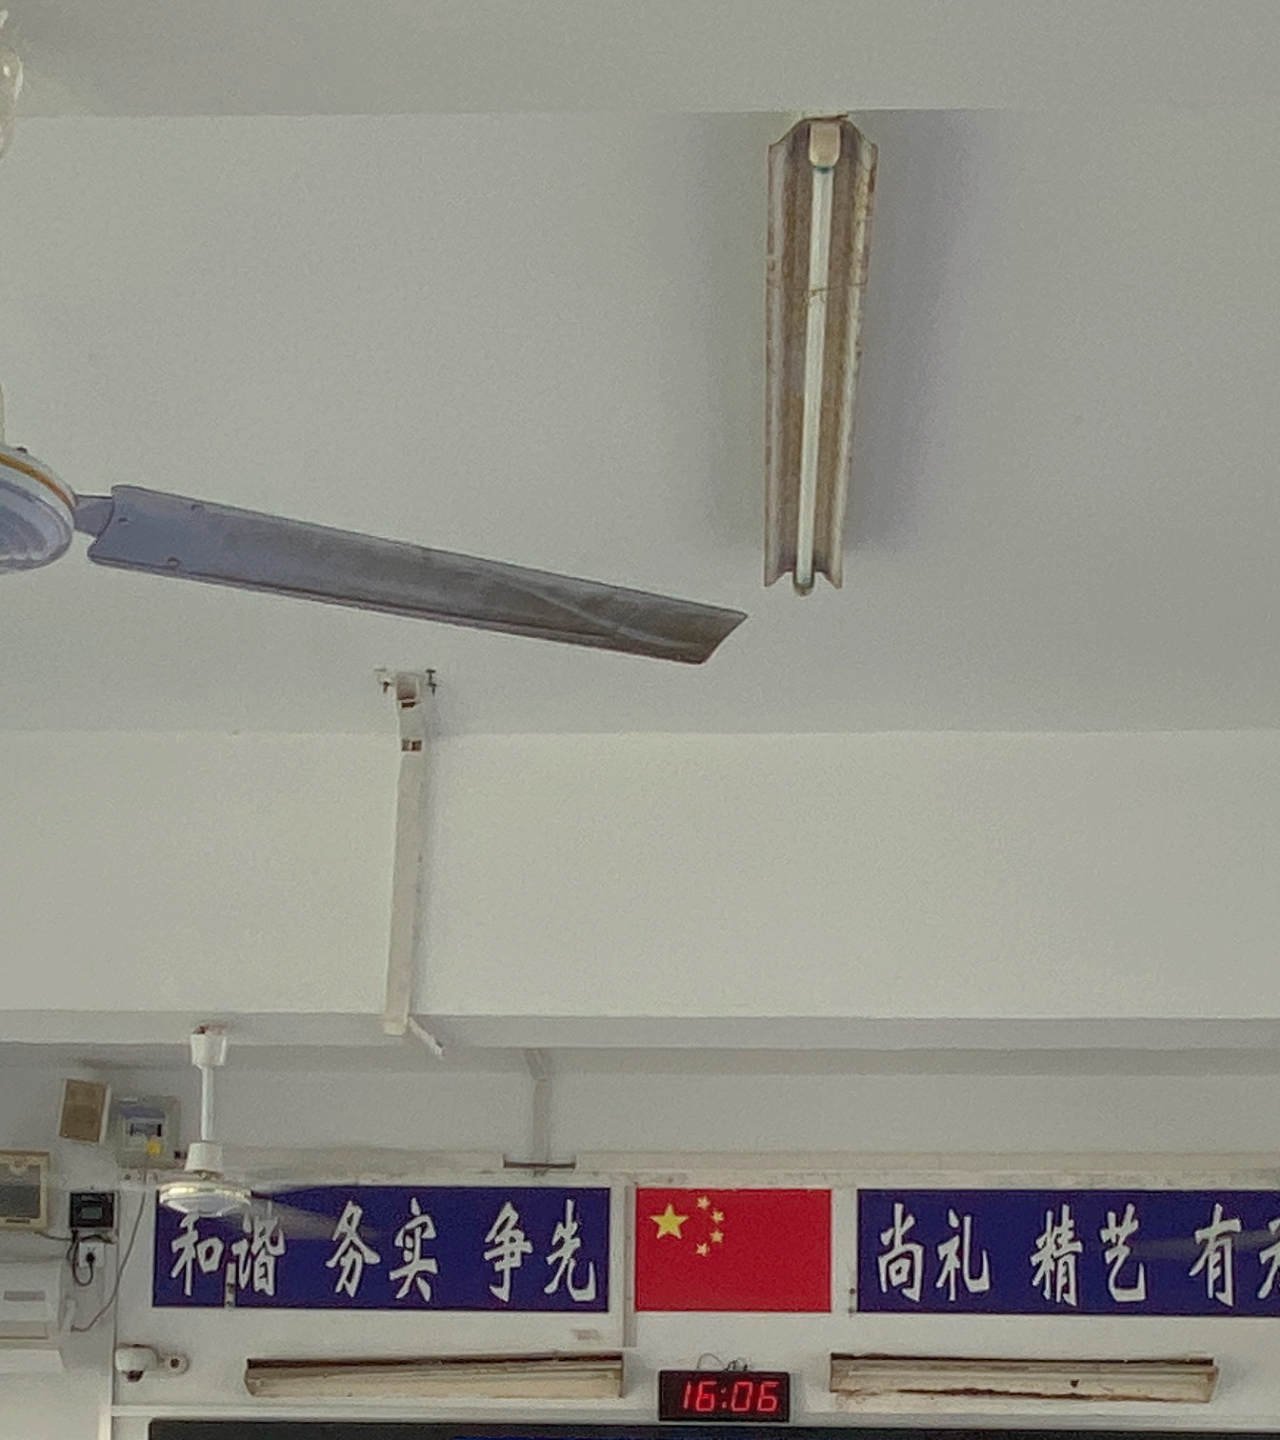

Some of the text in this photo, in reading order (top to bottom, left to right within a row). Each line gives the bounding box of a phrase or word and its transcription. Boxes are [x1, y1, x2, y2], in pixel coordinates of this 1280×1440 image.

[170, 1197, 597, 1303] 和谐 务实 争先
[877, 1203, 991, 1302] 尚礼
[1029, 1203, 1147, 1307] 精艺
[682, 1380, 780, 1413] 16:06
